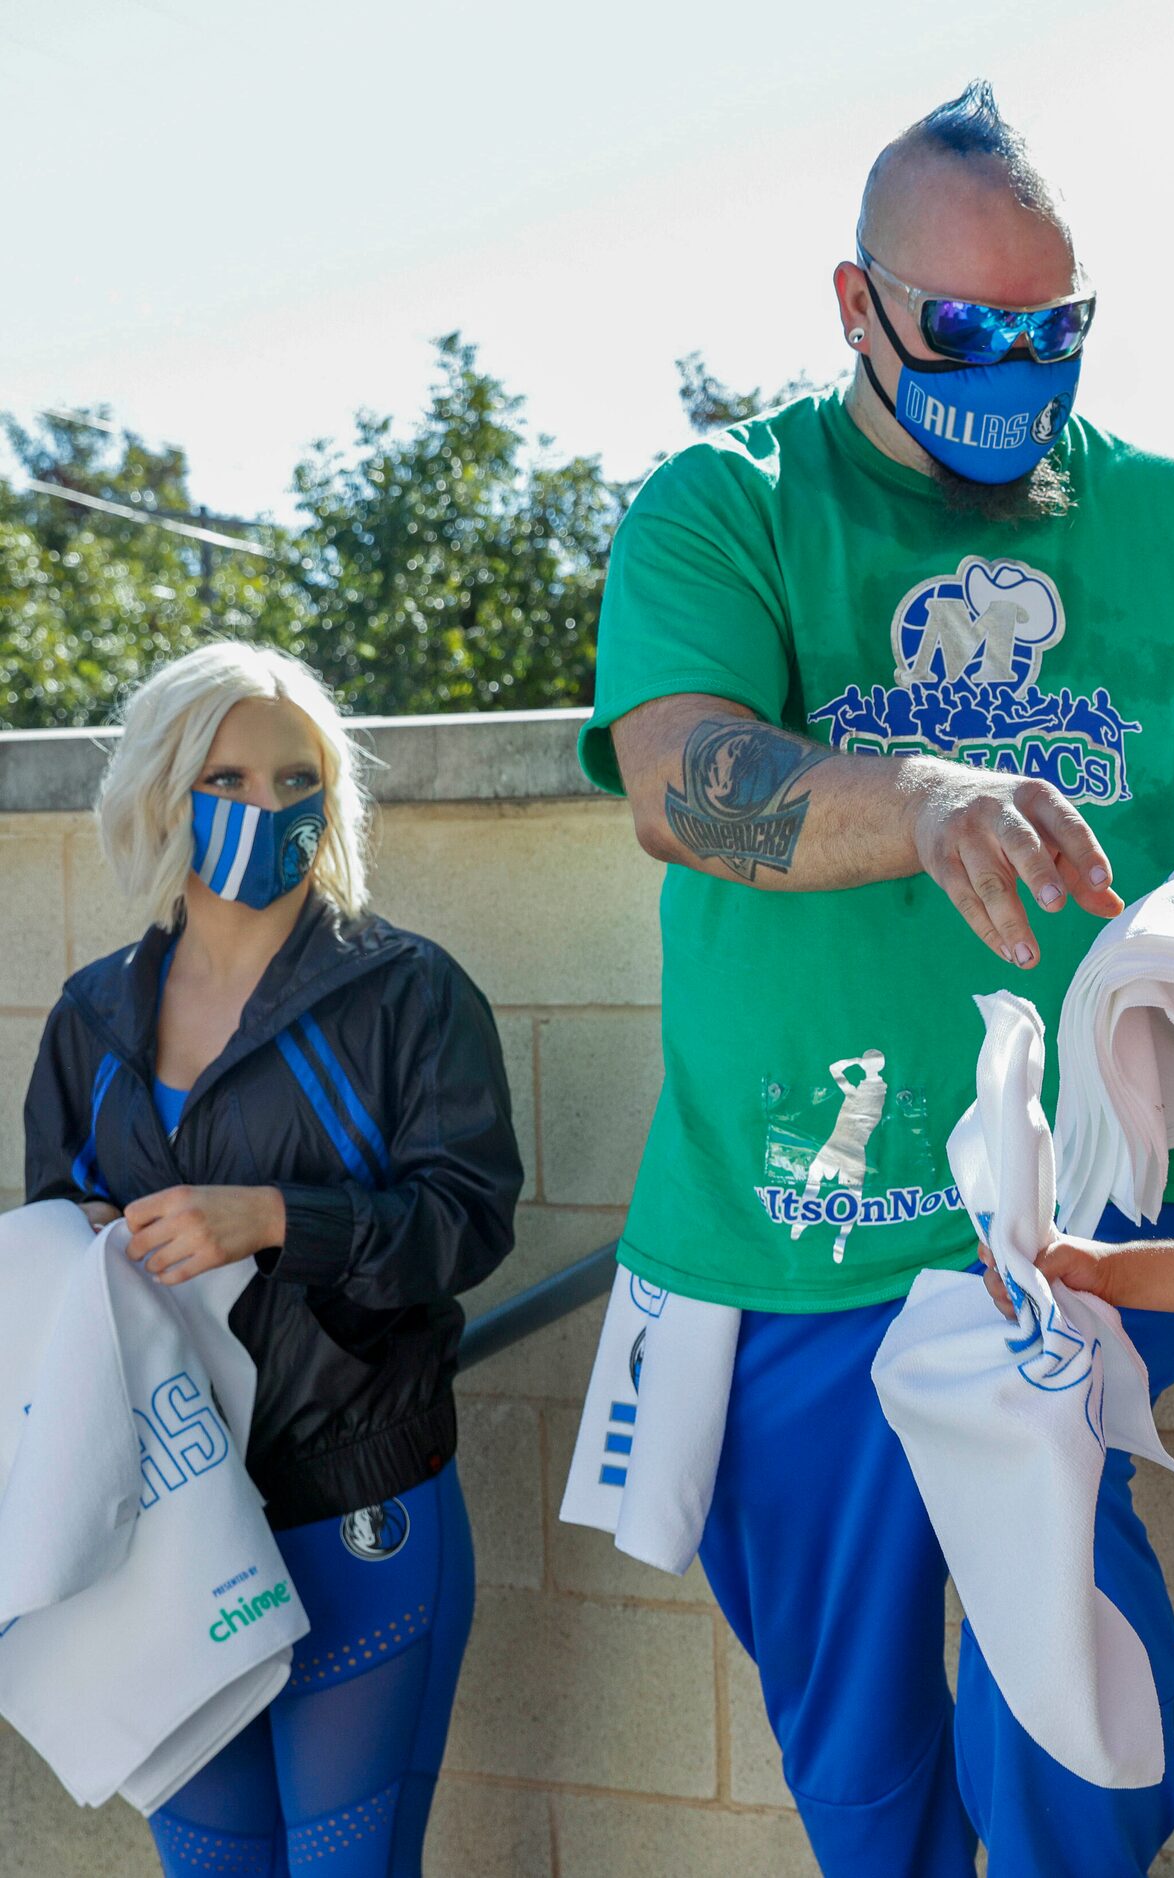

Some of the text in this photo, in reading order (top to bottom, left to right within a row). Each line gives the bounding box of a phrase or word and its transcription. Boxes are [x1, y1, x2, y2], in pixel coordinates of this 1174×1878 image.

[905, 380, 1030, 450] DALLAS
[895, 598, 1030, 683] M
[209, 1580, 292, 1643] chime
[211, 1570, 250, 1598] PRESENTED
